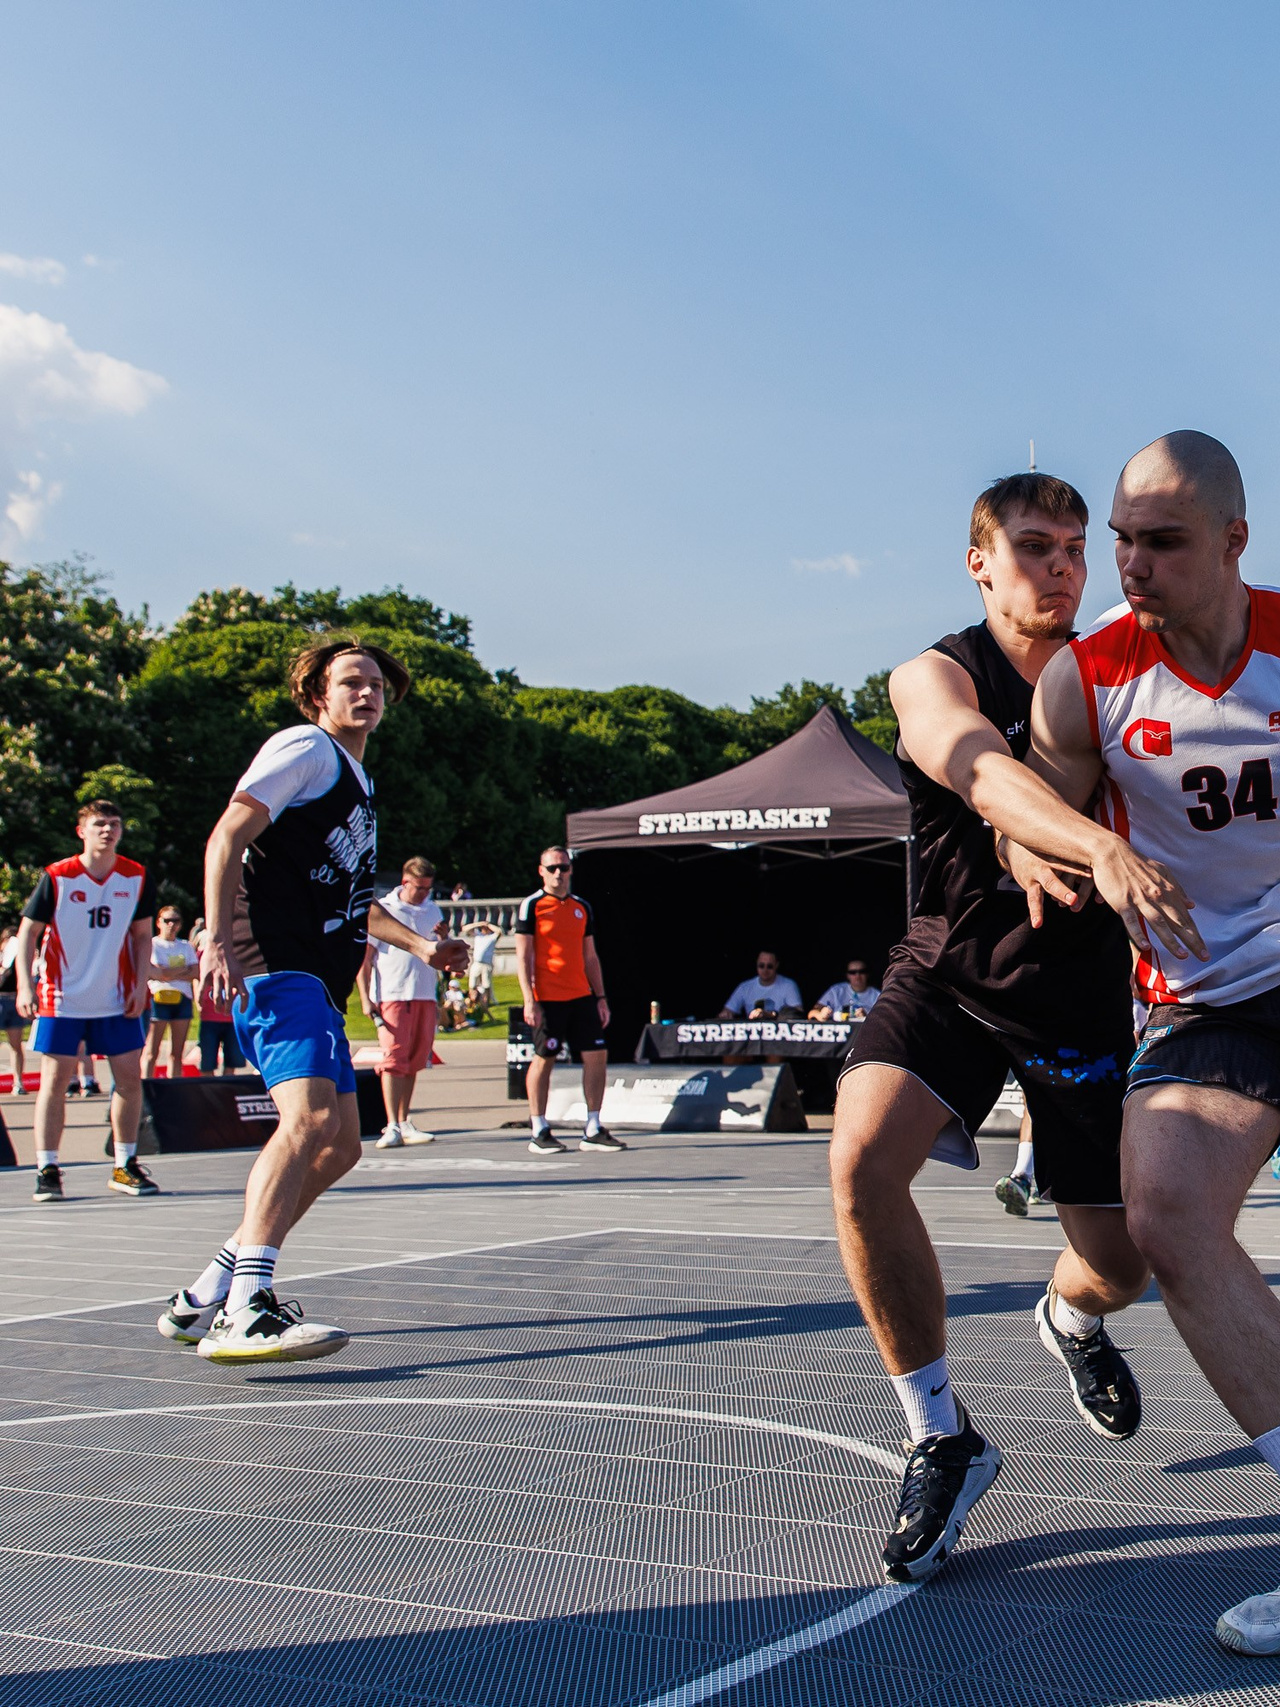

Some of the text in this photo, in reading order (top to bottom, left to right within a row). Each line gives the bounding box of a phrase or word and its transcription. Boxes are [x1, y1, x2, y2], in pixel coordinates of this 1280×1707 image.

[1181, 757, 1278, 832] 34
[638, 807, 831, 835] STREETBASKET
[87, 905, 112, 929] 16
[677, 1023, 851, 1042] STREETBASKET
